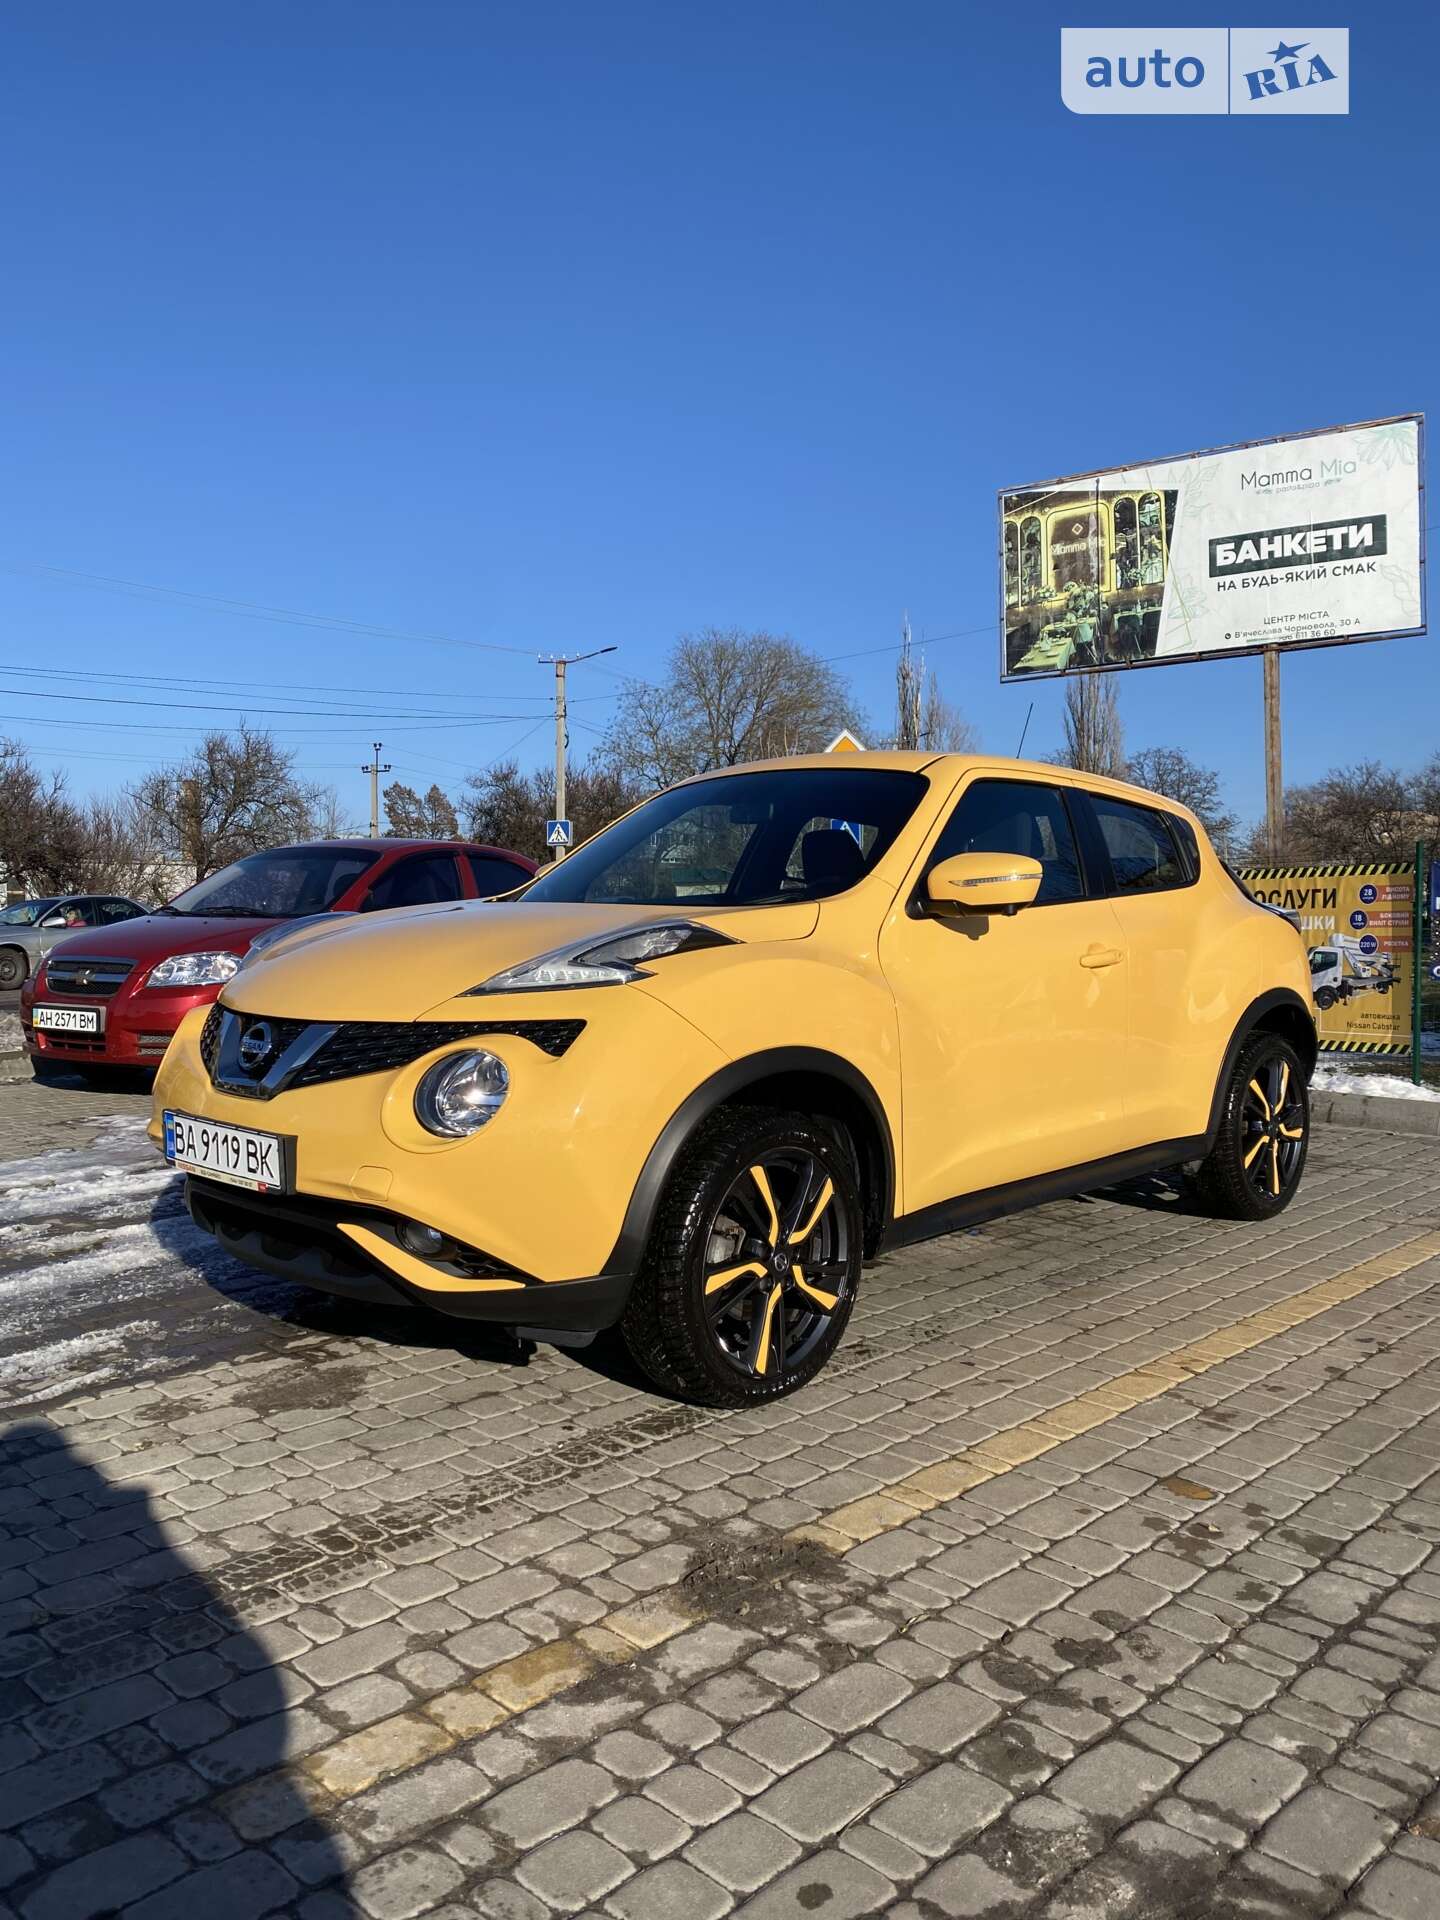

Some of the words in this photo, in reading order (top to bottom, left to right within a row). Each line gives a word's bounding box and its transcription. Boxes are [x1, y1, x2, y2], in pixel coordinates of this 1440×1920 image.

[1241, 468, 1312, 490] Mamma
[1320, 458, 1357, 478] Mia
[1216, 523, 1373, 567] БАНКЕТИ
[1217, 580, 1237, 592] НА
[1242, 565, 1327, 589] БУДЬ-ЯКИЙ
[1332, 561, 1377, 577] СМАК
[1263, 614, 1296, 625] ЦЕНТР
[1298, 610, 1330, 621] МІСТА
[1310, 630, 1321, 638] 36
[1324, 628, 1336, 636] 60
[1253, 887, 1337, 910] ОСЛУГИ
[1363, 888, 1373, 896] 28
[1300, 914, 1336, 931] ШКИ
[1355, 914, 1362, 922] 18
[39, 1011, 53, 1026] AH
[54, 1012, 77, 1029] 2571
[79, 1014, 95, 1029] BM
[1346, 1021, 1371, 1029] Nissan
[1372, 1022, 1400, 1031] Cabstar
[174, 1121, 197, 1159] BA
[201, 1129, 240, 1169] 9119
[247, 1138, 274, 1178] BK
